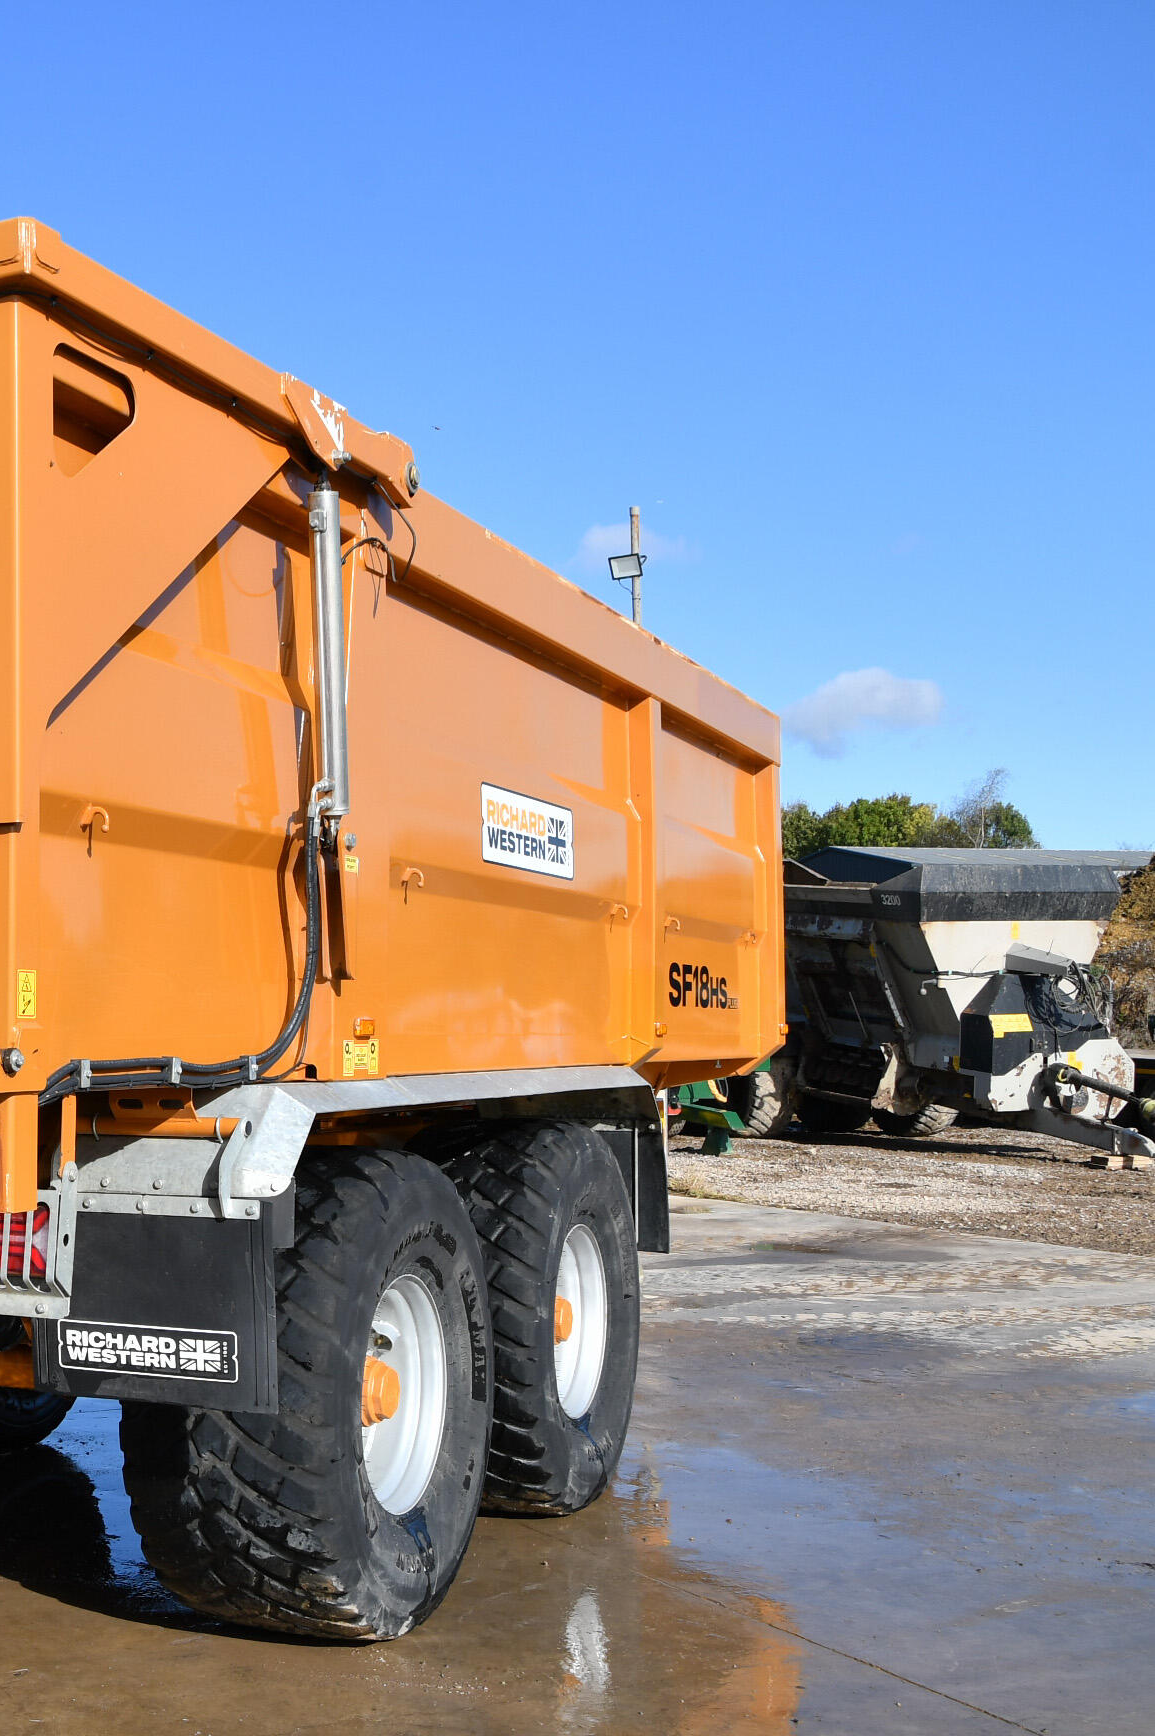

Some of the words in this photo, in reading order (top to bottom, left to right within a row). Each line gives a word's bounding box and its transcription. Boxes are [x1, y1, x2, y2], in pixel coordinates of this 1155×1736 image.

[486, 799, 546, 836] RICHARD
[487, 826, 546, 860] WESTERN
[881, 894, 901, 905] 3200
[65, 1329, 177, 1354] RICHARD
[67, 1346, 176, 1369] WESTERN
